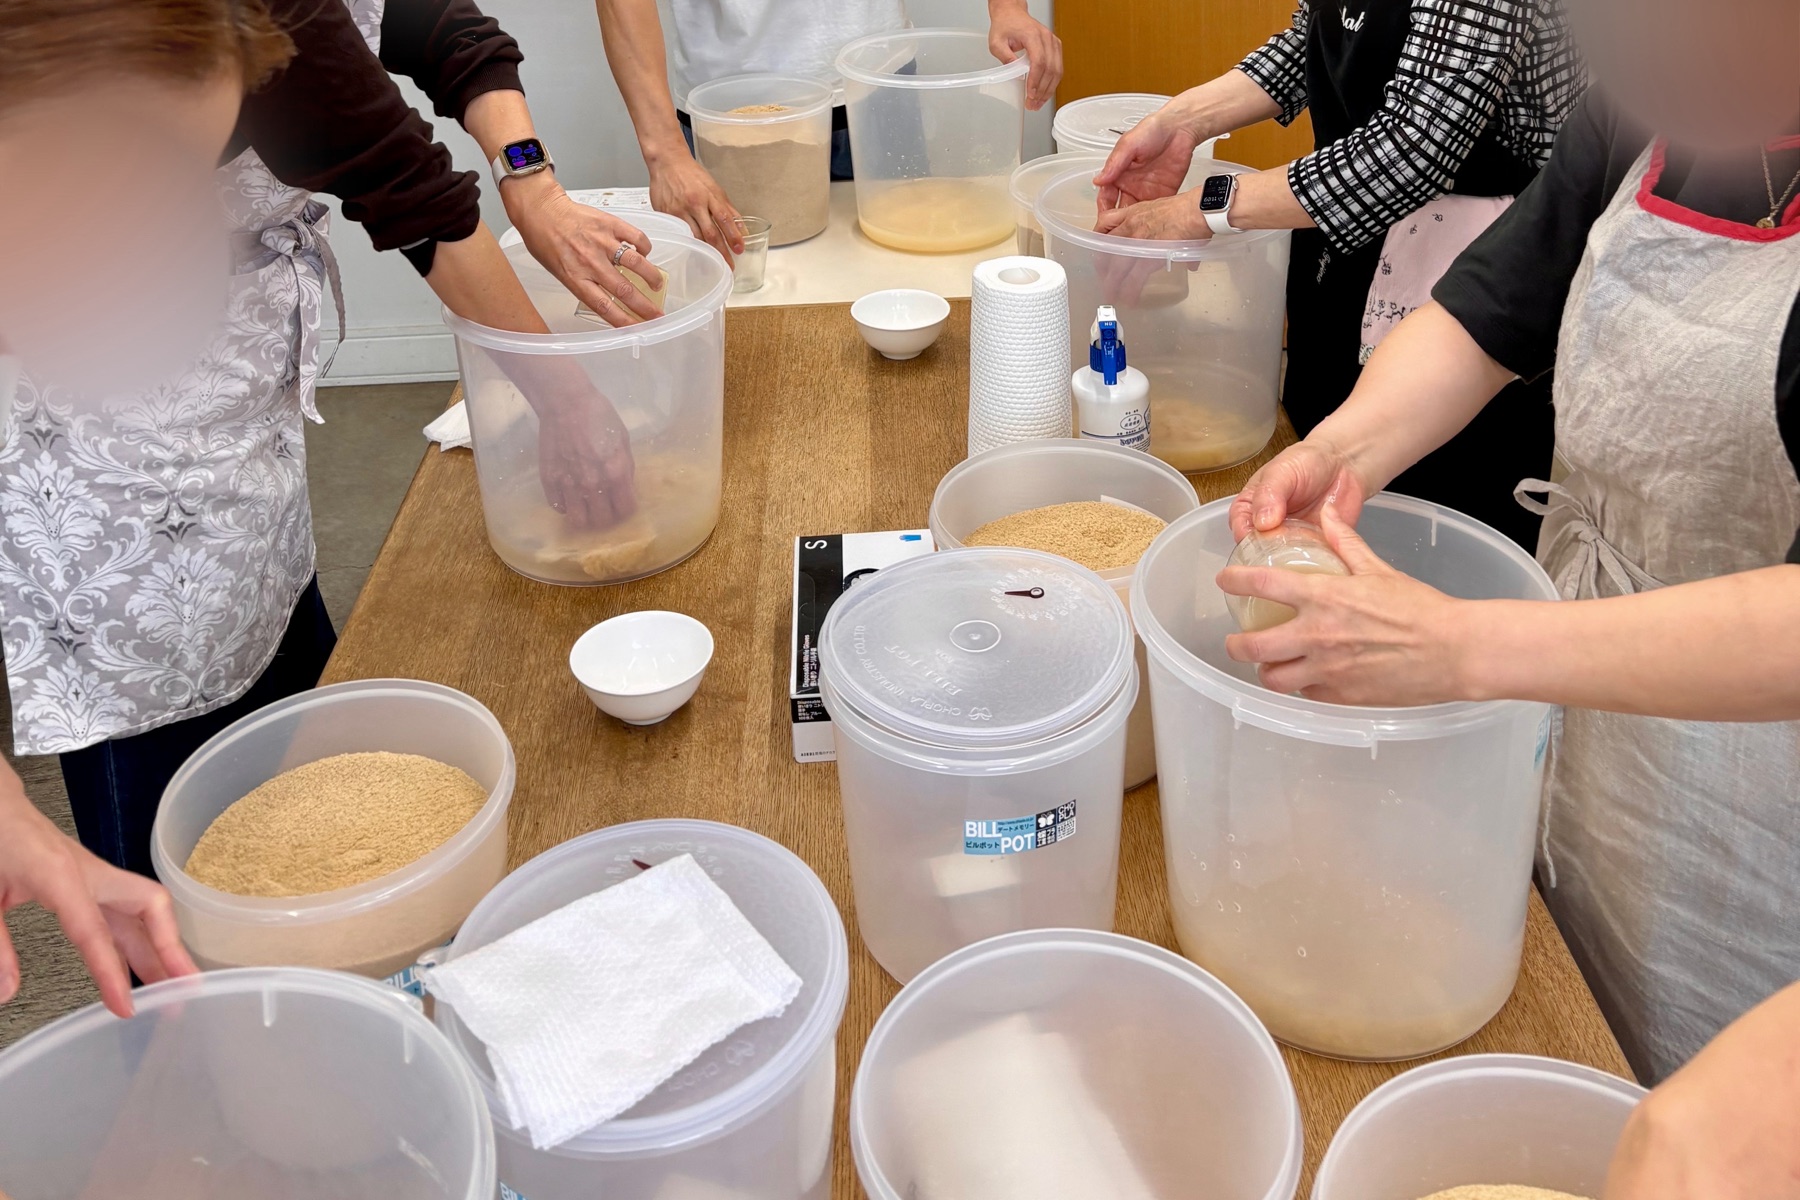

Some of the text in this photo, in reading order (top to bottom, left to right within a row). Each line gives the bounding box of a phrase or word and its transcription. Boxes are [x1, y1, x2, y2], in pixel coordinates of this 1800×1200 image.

[804, 539, 828, 550] S
[860, 658, 905, 697] INDUSTRY
[909, 696, 962, 716] CHOPLA
[1058, 801, 1075, 815] CHO
[1058, 810, 1075, 822] PLA
[965, 821, 1003, 838] BILL
[965, 841, 1000, 850] ビルポット
[1001, 832, 1035, 854] POT
